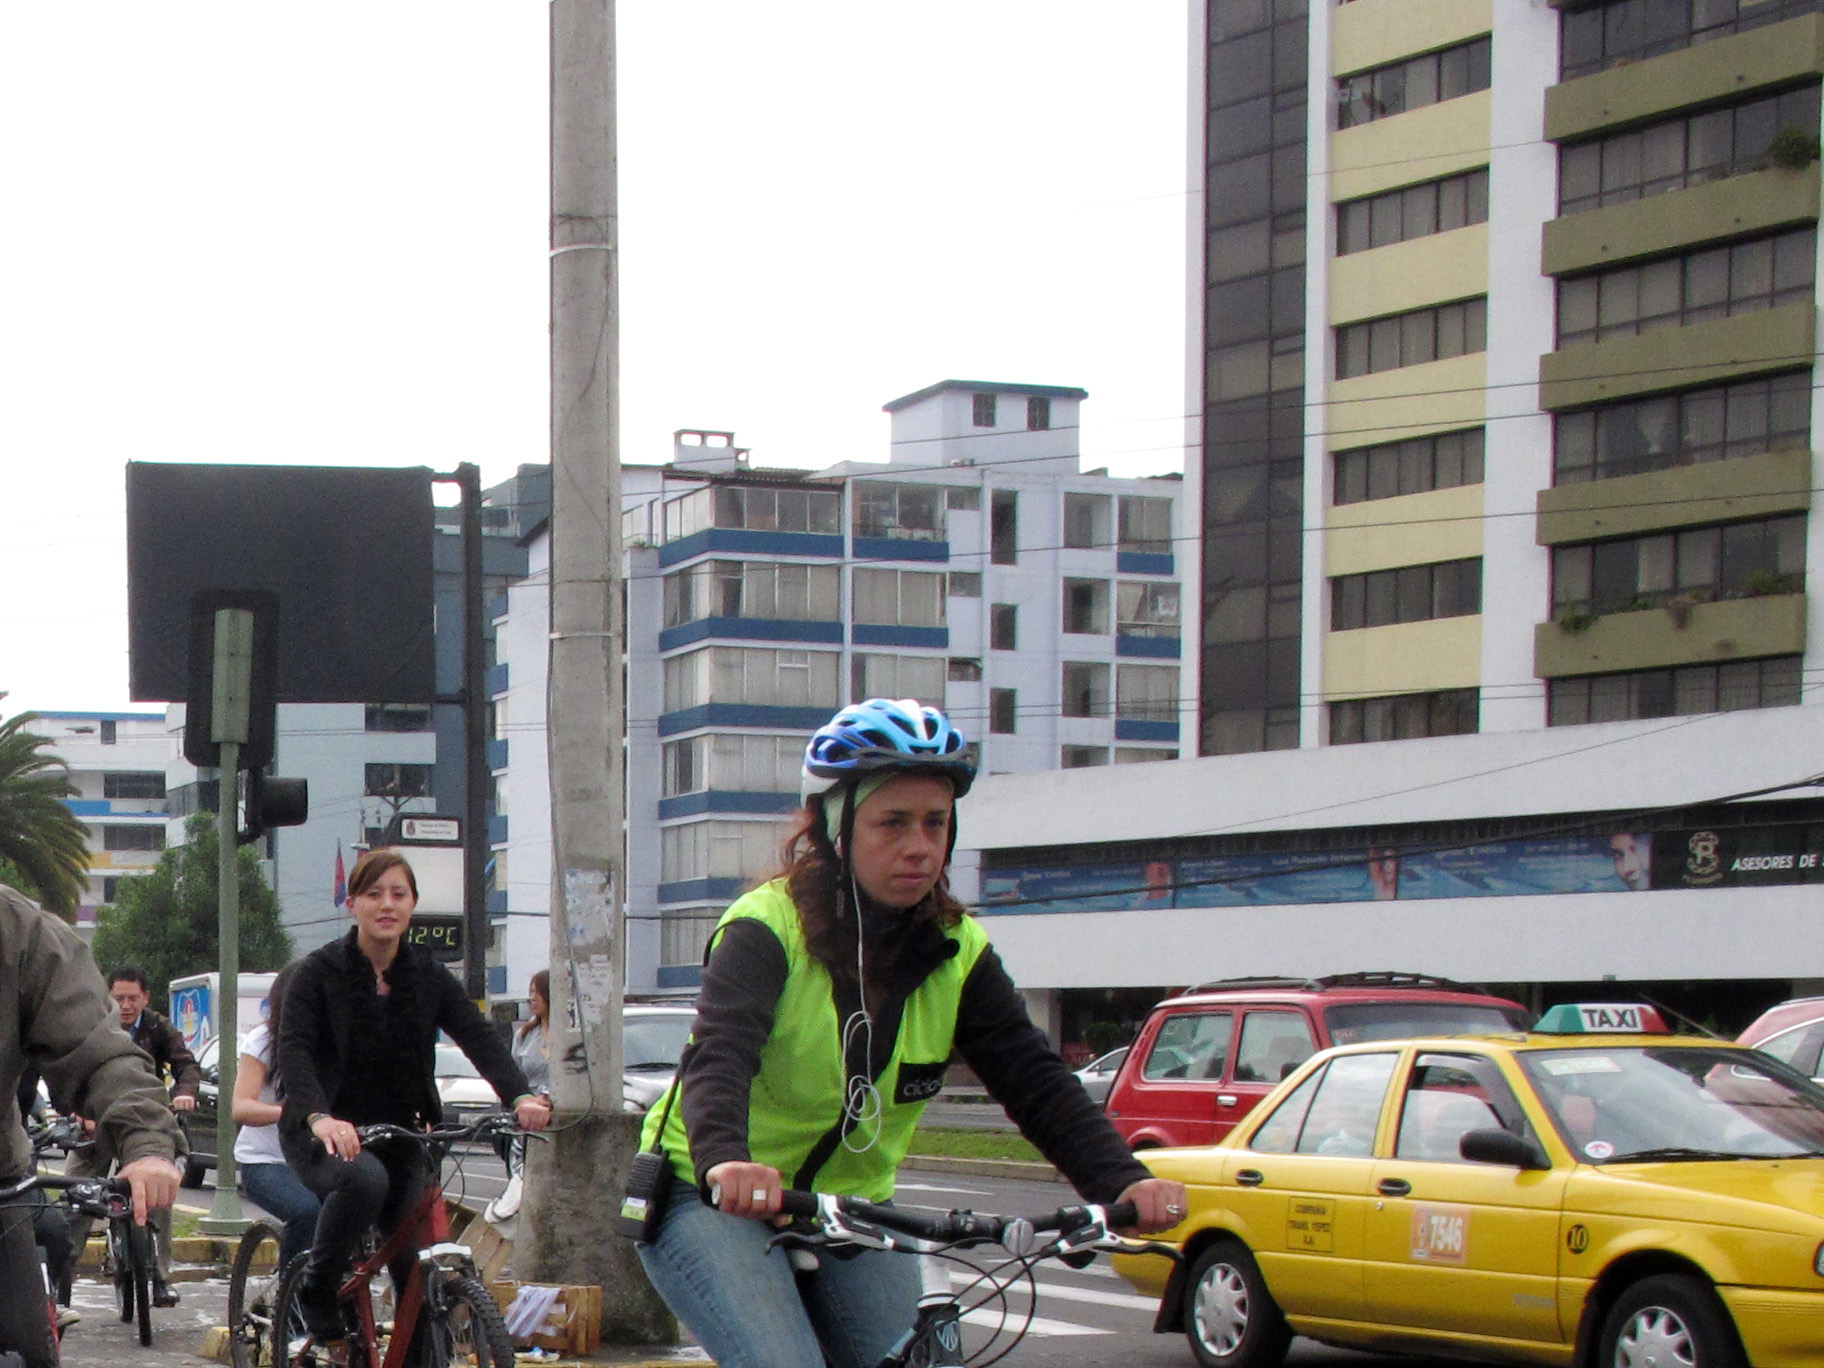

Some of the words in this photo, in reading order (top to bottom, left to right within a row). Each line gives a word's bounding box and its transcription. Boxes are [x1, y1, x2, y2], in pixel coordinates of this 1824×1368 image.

[1731, 855, 1794, 871] ASESORES
[1798, 854, 1818, 868] DE
[1581, 1009, 1638, 1028] TAXI
[1571, 1228, 1587, 1249] 10
